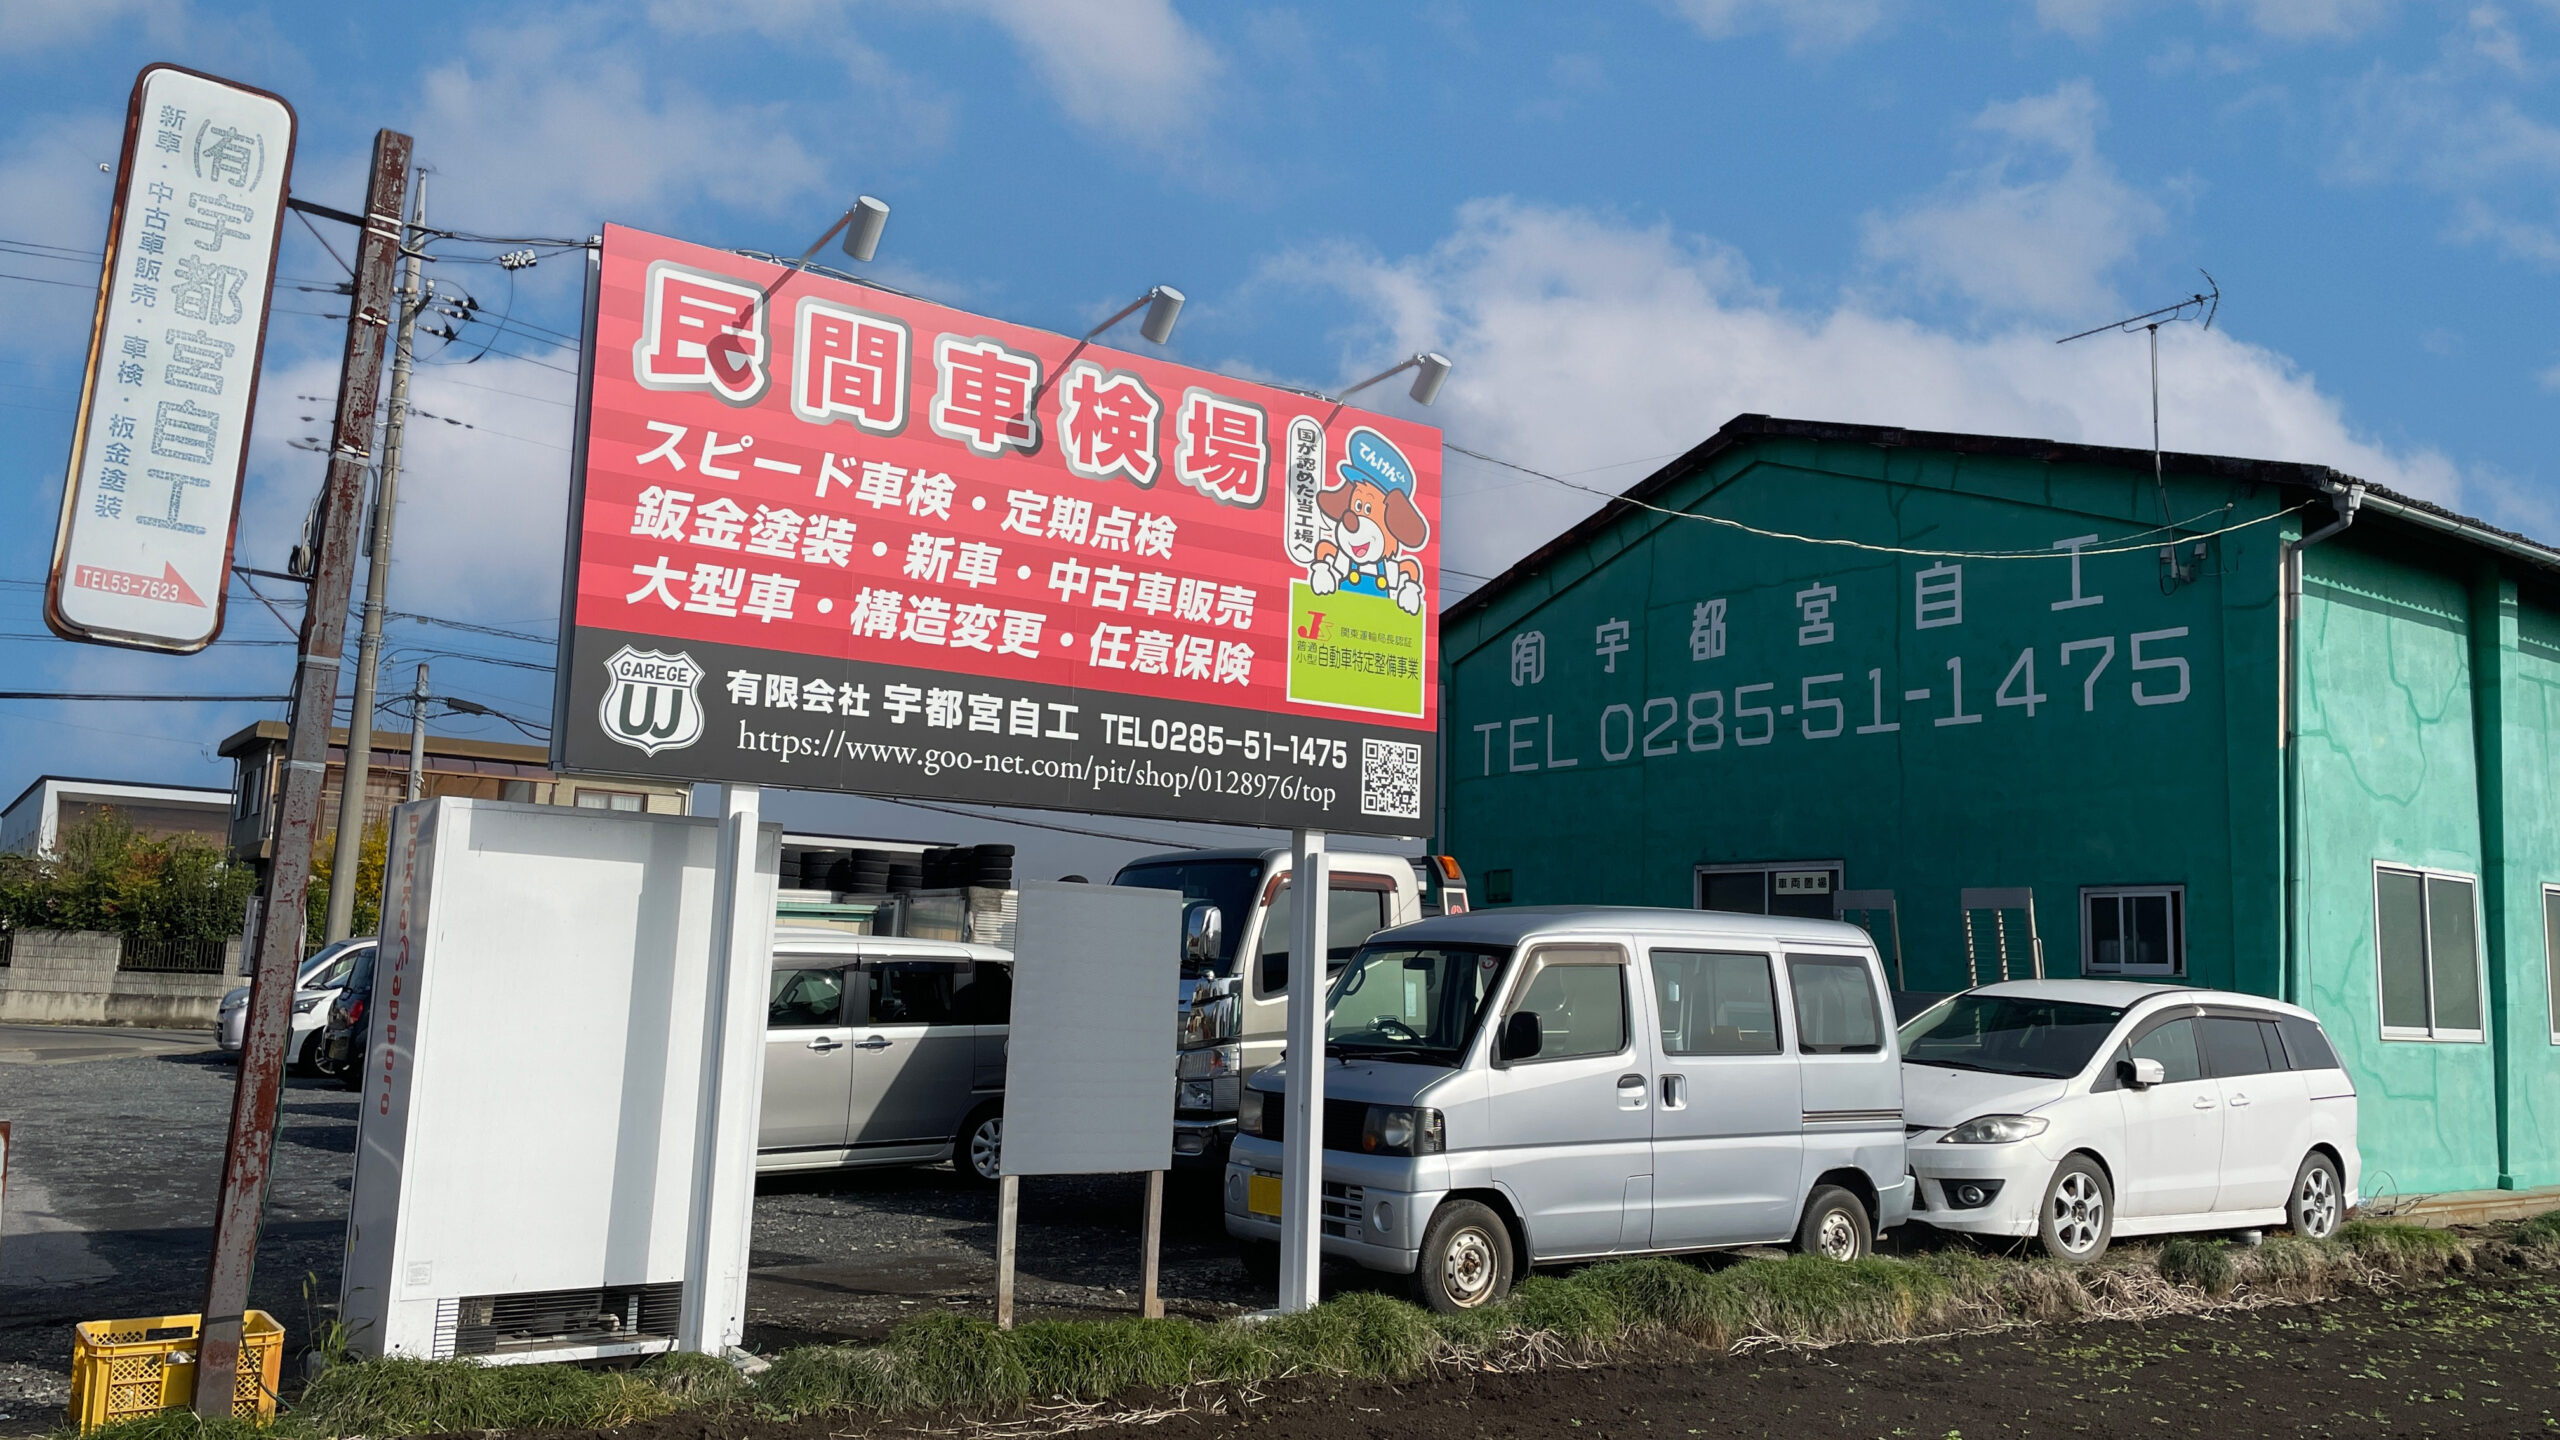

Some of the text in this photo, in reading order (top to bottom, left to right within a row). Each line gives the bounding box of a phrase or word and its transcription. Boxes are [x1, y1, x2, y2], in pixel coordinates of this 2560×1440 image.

[635, 261, 1268, 504] 民間車検場
[636, 420, 1178, 560] スピード車検・定期点検
[1294, 427, 1317, 554] 国が認めた当工場へ
[1359, 441, 1406, 484] てんけんくん
[83, 569, 179, 601] TEL53-7623
[631, 485, 1257, 631] 鈑金塗装・新車・中古車販売
[620, 661, 689, 683] GAREGE
[626, 555, 1256, 687] 大型車・構造変更・任意保険
[1318, 644, 1419, 681] 自動車特定整備事業
[726, 669, 870, 717] 有限会社
[883, 683, 1080, 741] 宇都宮自工
[1473, 626, 2191, 776] TEL 0285-51-1475
[736, 719, 1336, 809] https://www.goo-net.com/pit/shop/0128976/top
